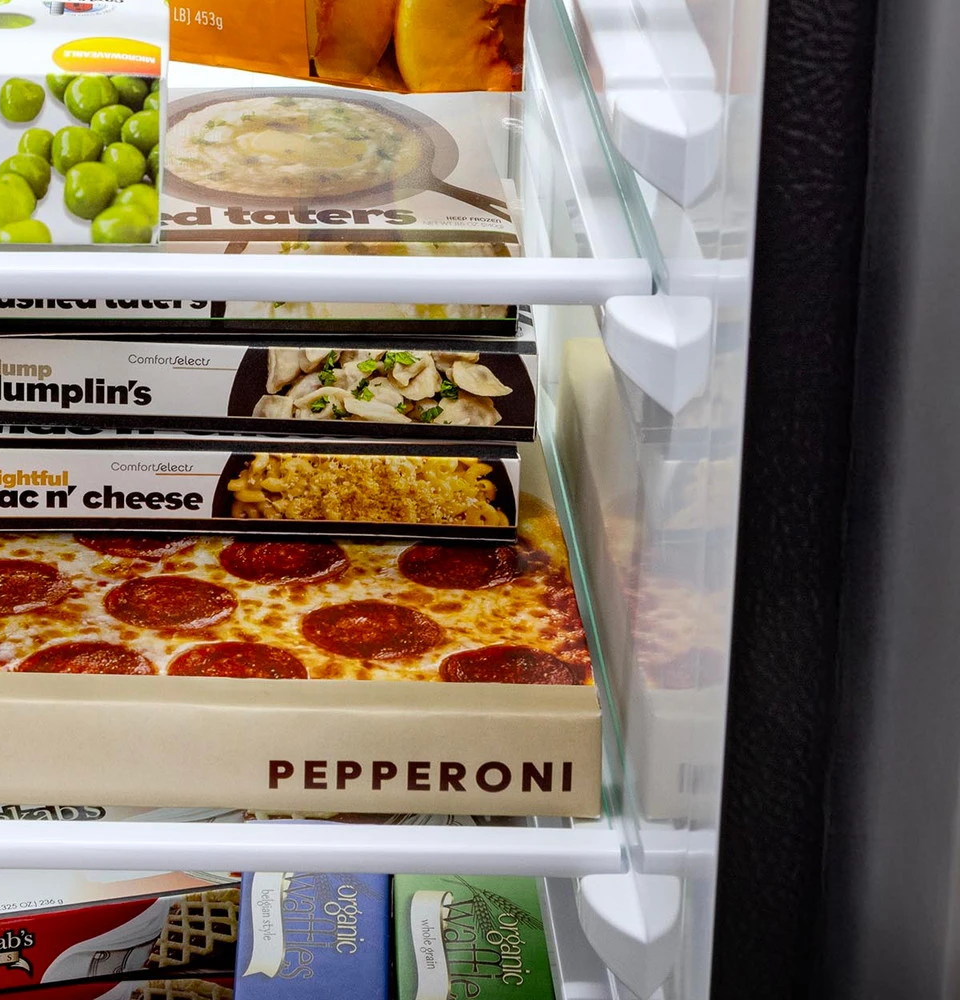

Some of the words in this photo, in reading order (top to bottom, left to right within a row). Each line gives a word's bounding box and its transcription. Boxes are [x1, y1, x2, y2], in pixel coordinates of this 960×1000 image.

[194, 10, 223, 30] 453g
[224, 205, 417, 225] taters
[46, 485, 77, 508] n'
[82, 485, 204, 511] cheese
[268, 760, 573, 793] PEPPERONI
[257, 888, 276, 918] belgian
[258, 920, 275, 942] style
[278, 872, 337, 980] waffles
[323, 884, 365, 955] organic
[421, 918, 435, 945] whole
[420, 946, 437, 970] grain
[442, 898, 503, 1000] waffle
[486, 913, 531, 986] organic
